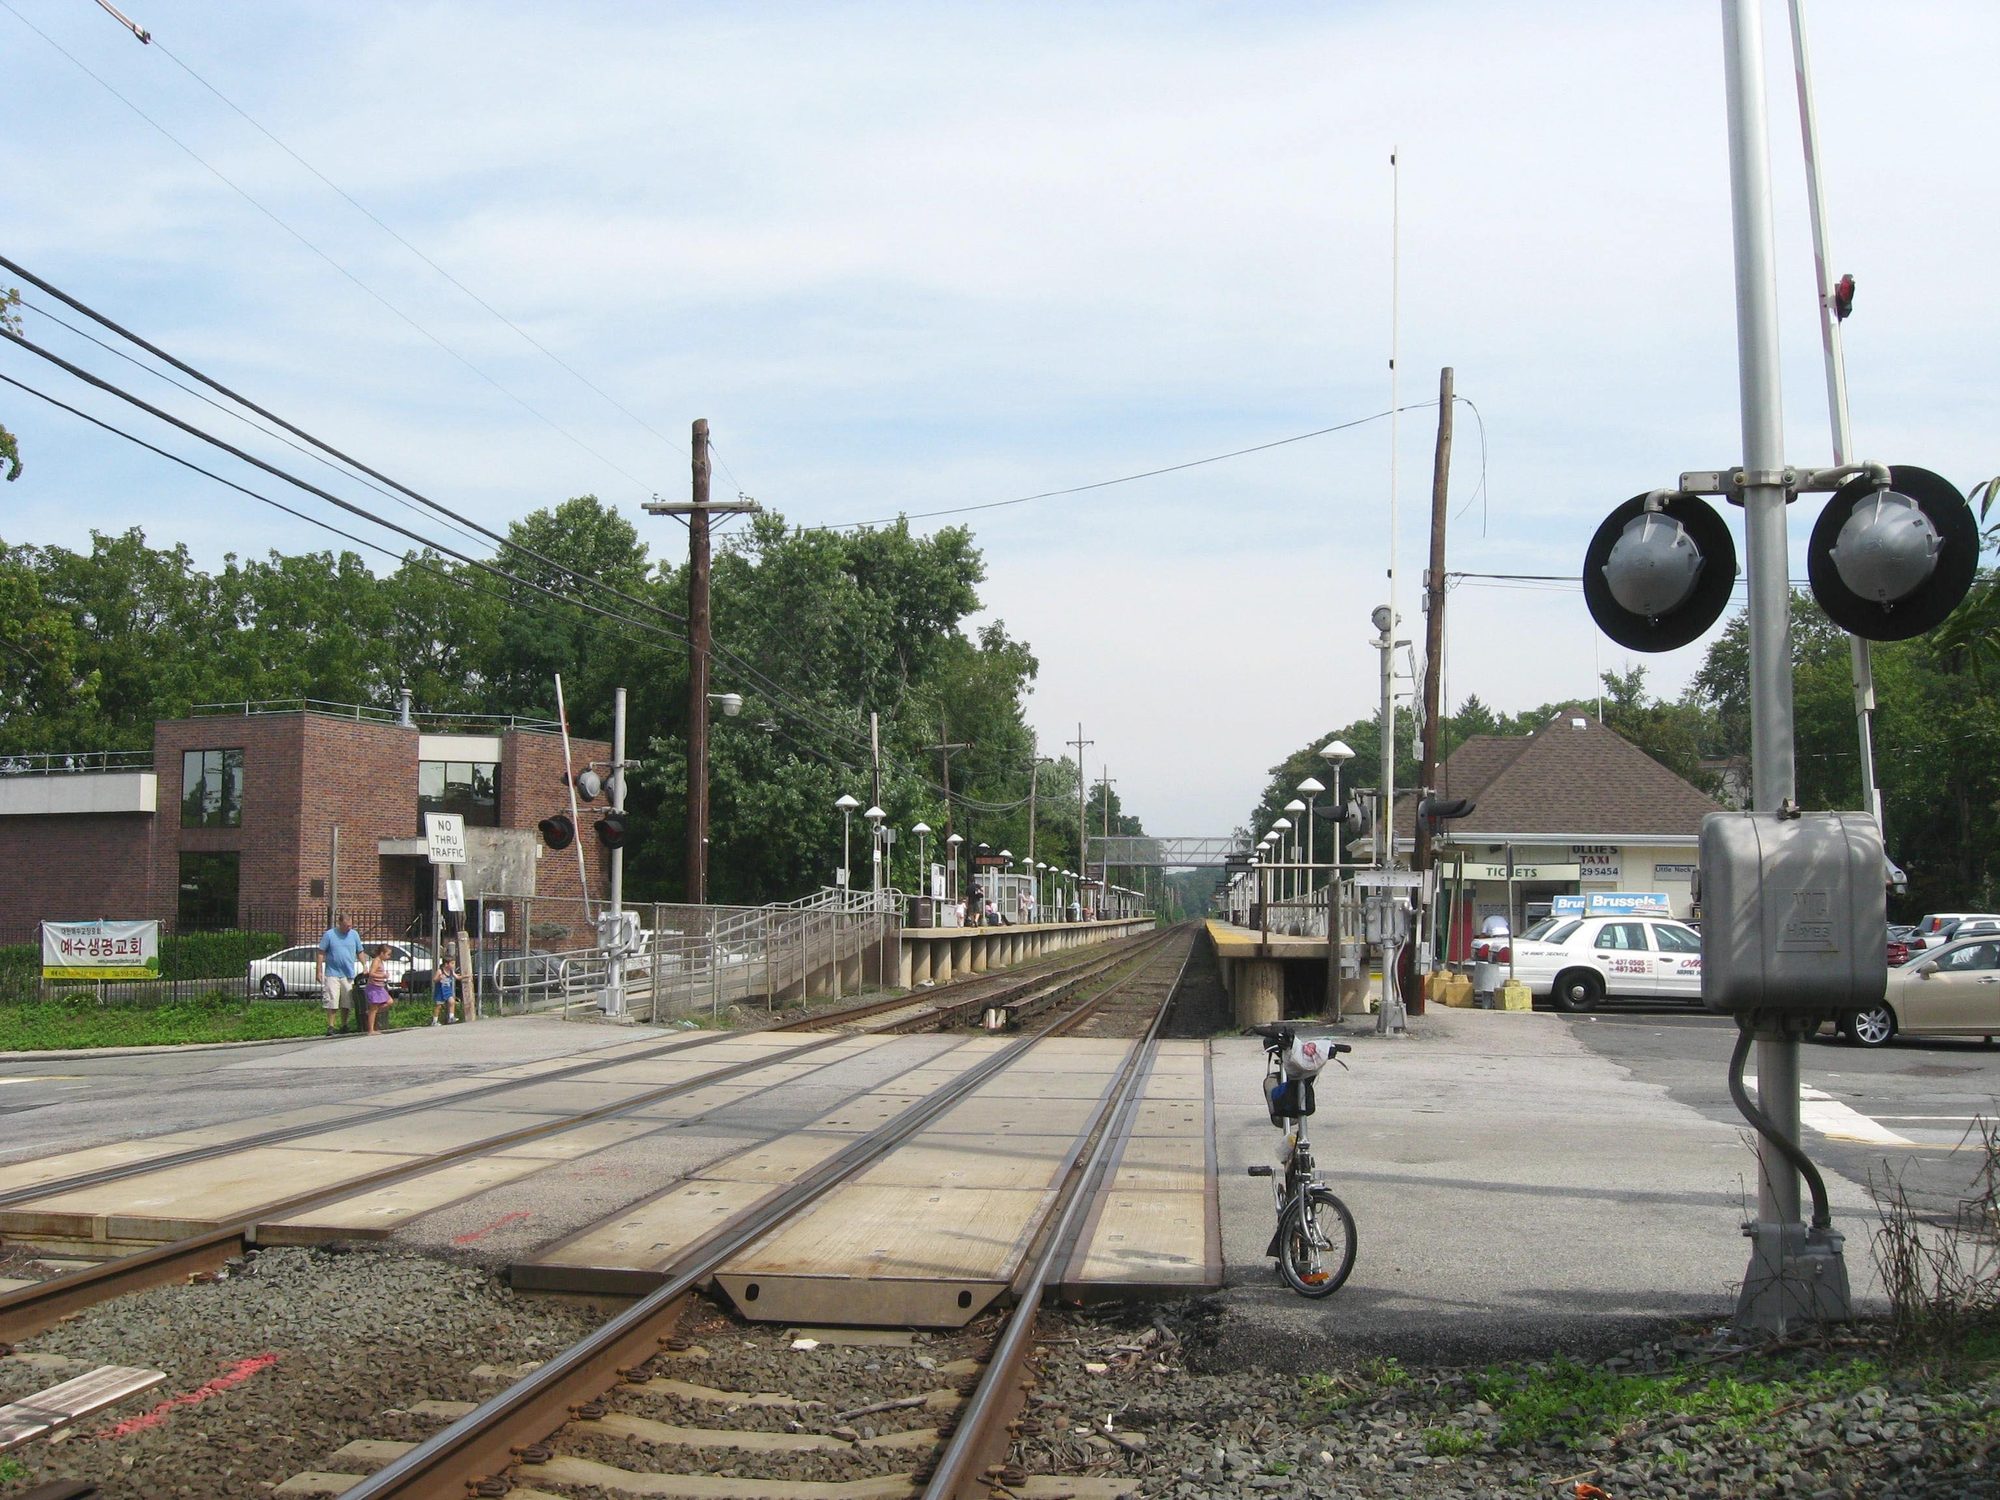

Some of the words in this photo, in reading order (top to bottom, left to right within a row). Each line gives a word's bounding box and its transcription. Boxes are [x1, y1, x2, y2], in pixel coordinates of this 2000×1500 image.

[438, 820, 451, 831] NO
[435, 835, 457, 845] THRU
[431, 847, 463, 857] TRAFFIC
[1579, 855, 1610, 864] TAXI
[1486, 867, 1537, 877] TICETS
[1592, 895, 1657, 907] Brussels
[60, 937, 142, 956] 예수생명교회
